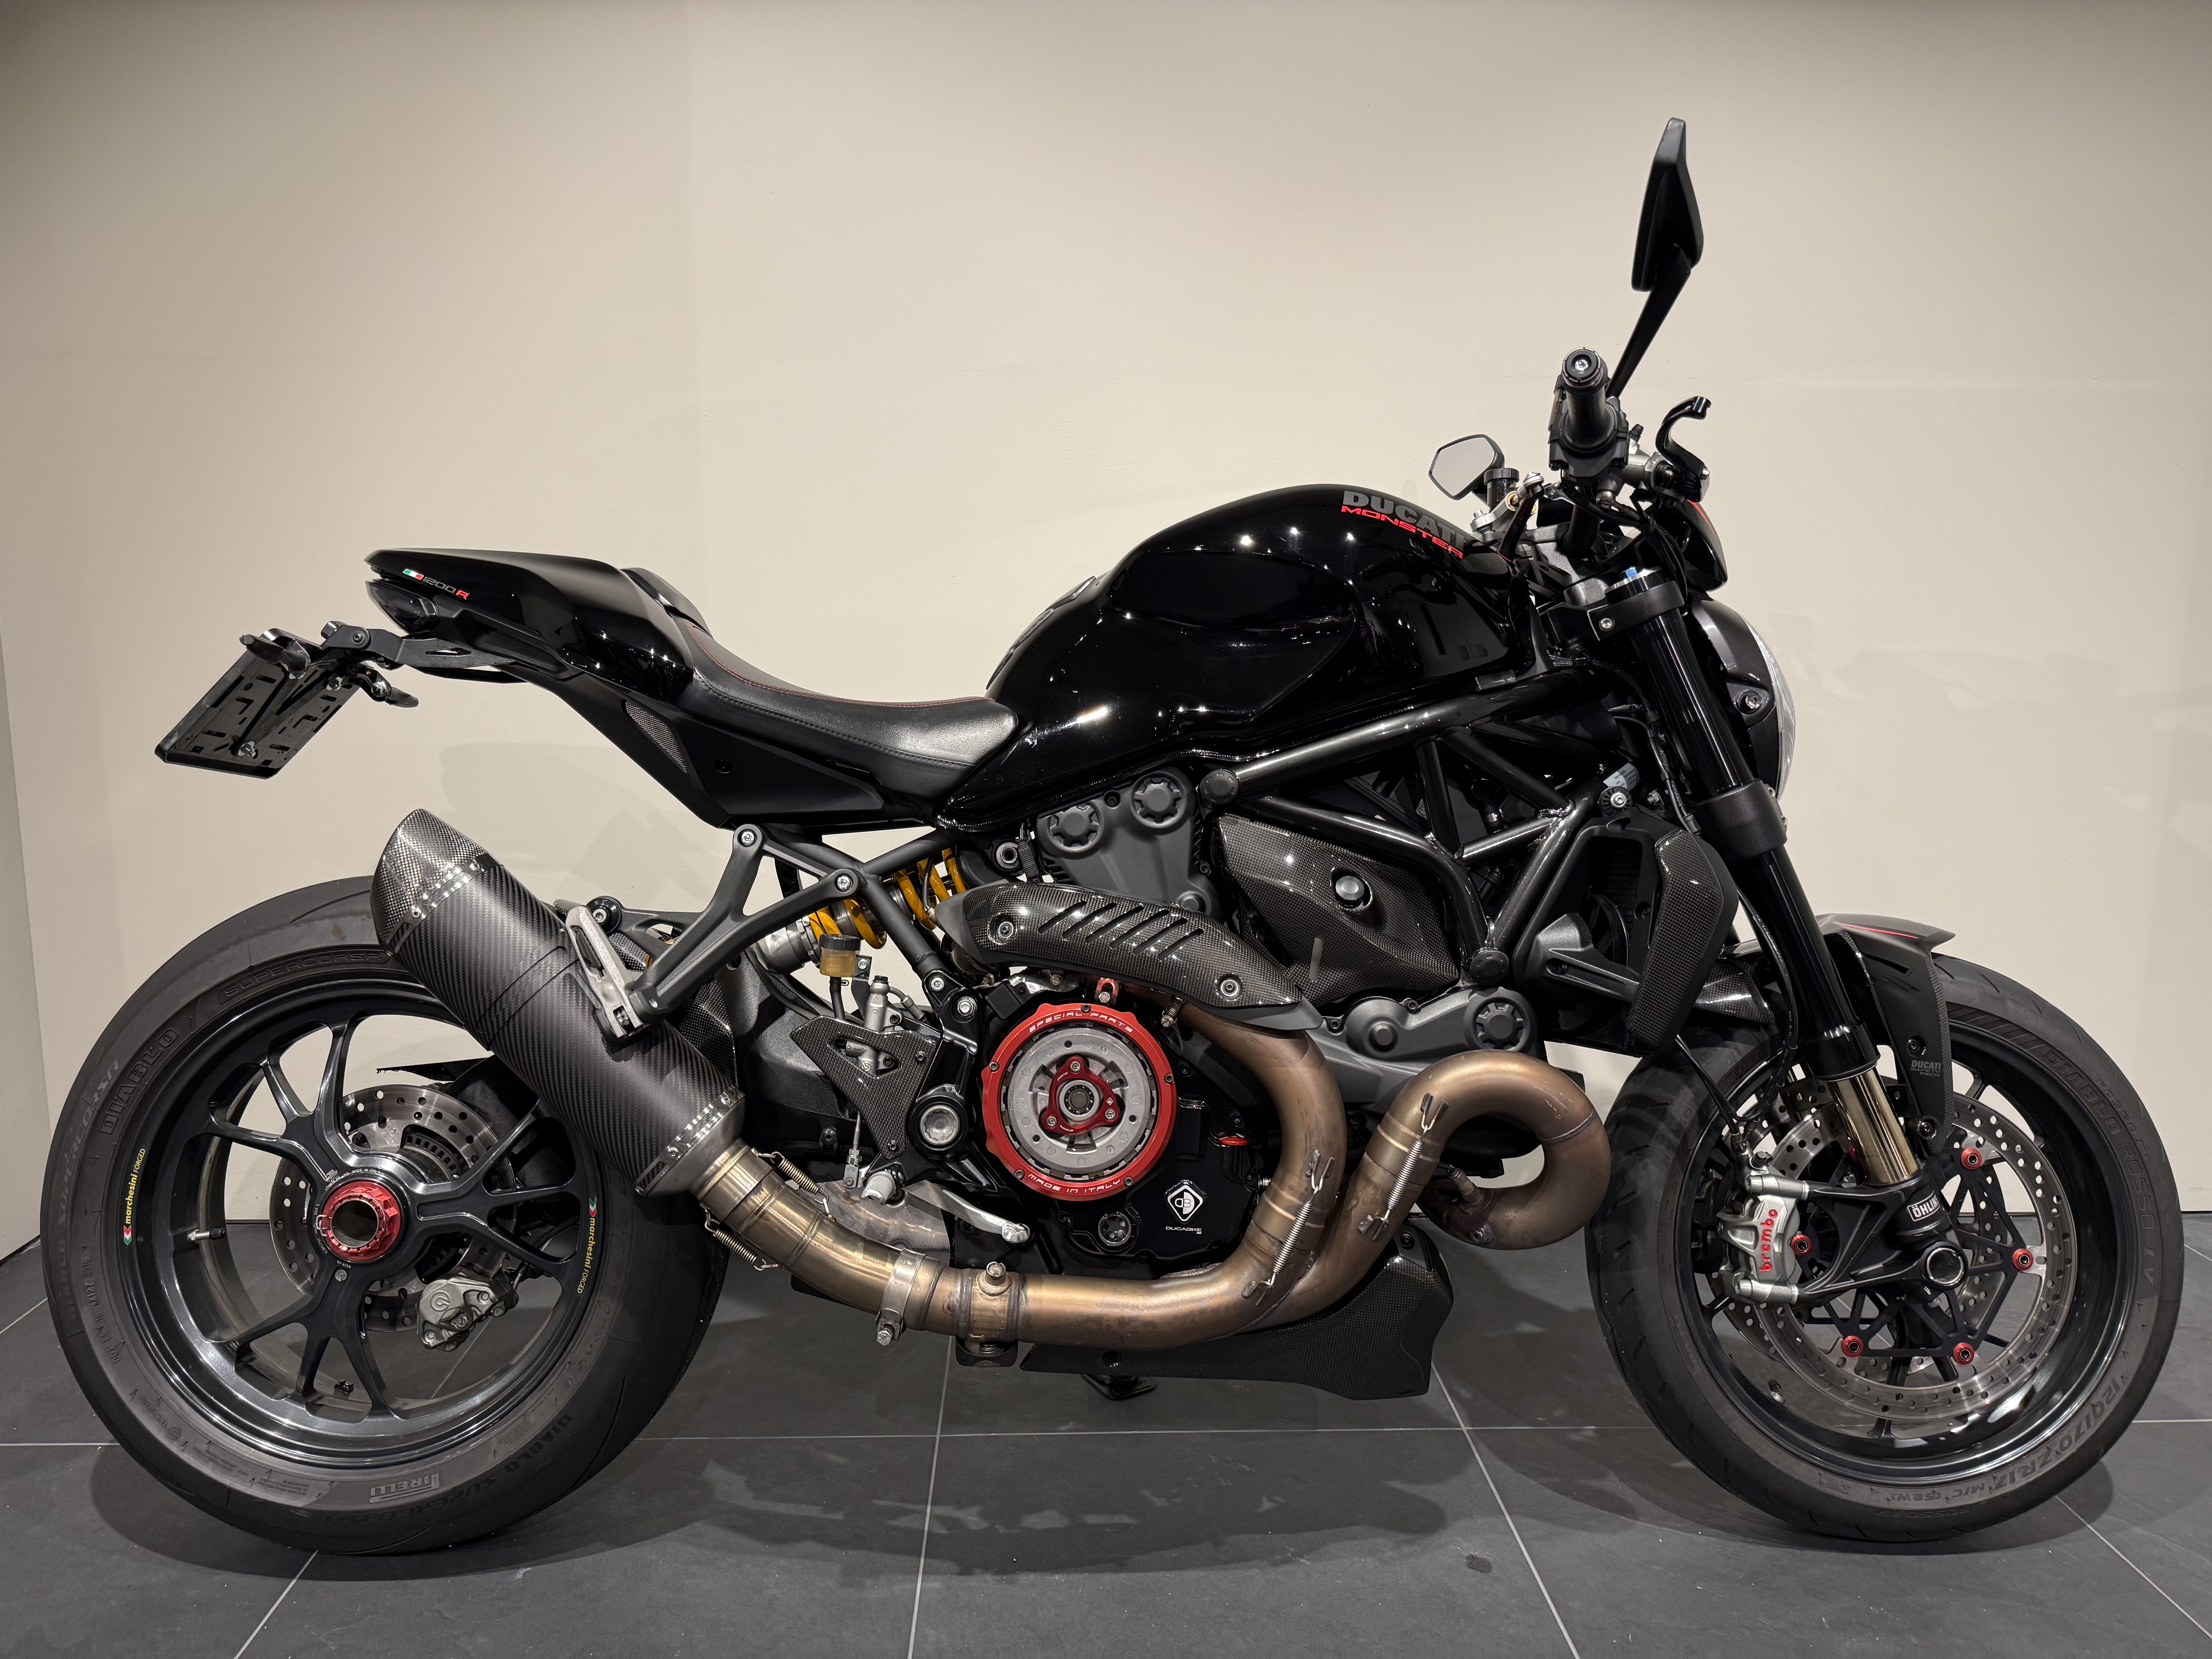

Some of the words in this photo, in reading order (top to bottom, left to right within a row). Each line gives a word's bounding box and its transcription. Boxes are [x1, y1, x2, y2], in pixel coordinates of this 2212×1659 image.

[1341, 506, 1463, 559] MONSTER
[1343, 491, 1465, 551] DUCATI
[422, 577, 457, 594] 1200
[455, 589, 470, 600] R
[222, 951, 383, 999] SUPERCORSA
[1029, 1012, 1082, 1033] SPECIAL
[1090, 1012, 1133, 1033] PARTS
[97, 1027, 179, 1135] DIABLO
[1911, 1060, 1941, 1070] DUCATI
[2043, 1046, 2121, 1135] DIABLO
[2118, 1141, 2155, 1230] ROSSO
[125, 1173, 139, 1225] marchesini
[133, 1148, 146, 1174] FORGED
[1028, 1173, 1061, 1191] MADE
[1084, 1178, 1121, 1194] ITALY
[584, 1217, 596, 1269] marchesini
[1759, 1209, 1778, 1272] brembo
[577, 1268, 589, 1294] FORGED
[369, 1473, 441, 1503] PIRELLI
